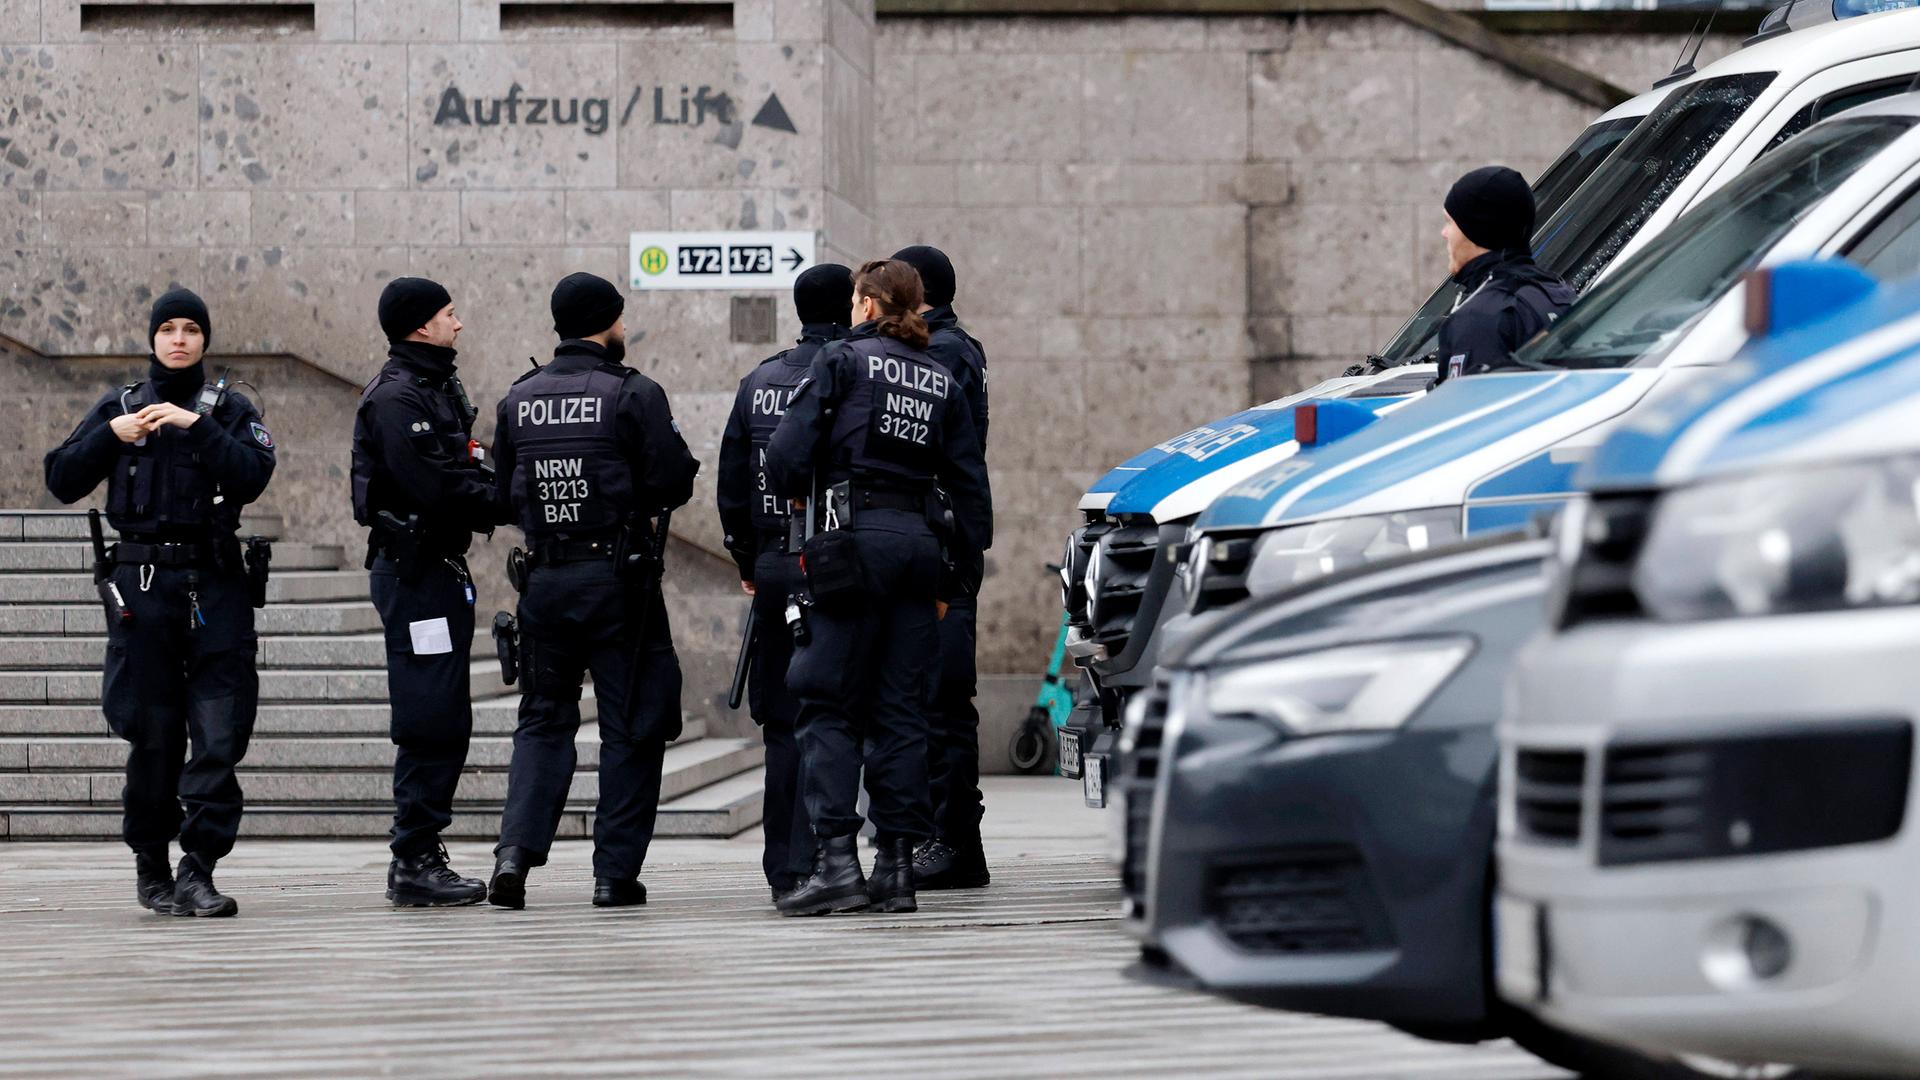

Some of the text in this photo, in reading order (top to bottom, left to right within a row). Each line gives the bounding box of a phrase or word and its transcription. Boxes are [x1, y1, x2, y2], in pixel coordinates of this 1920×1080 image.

[433, 85, 733, 134] Aufzug / Lift
[679, 248, 721, 272] 172
[730, 248, 772, 272] 173
[867, 355, 950, 400] POLIZEI
[517, 397, 603, 427] POLIZEI
[886, 392, 934, 422] NRW
[879, 413, 929, 446] 31212
[534, 457, 583, 479] NRW
[537, 479, 589, 501] 31213
[544, 503, 582, 523] BAT
